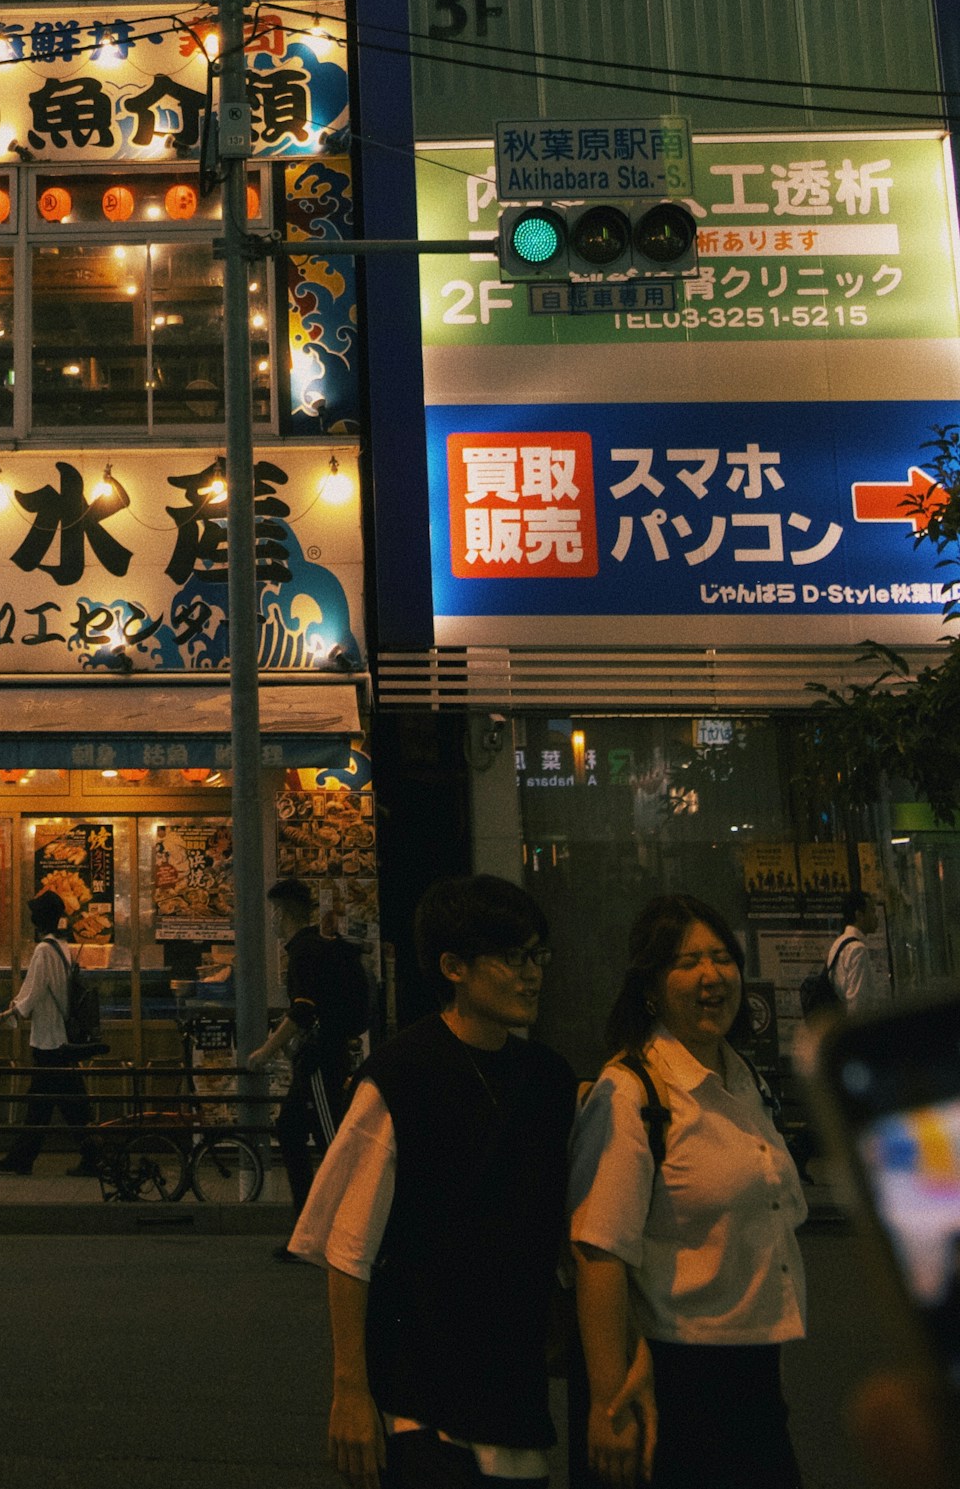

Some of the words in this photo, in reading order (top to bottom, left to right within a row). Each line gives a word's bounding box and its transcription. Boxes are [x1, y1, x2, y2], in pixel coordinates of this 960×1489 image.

[503, 128, 683, 163] 秋葉原駅南
[508, 167, 609, 191] Akihabara
[441, 279, 515, 325] 2F
[462, 447, 579, 503] 買取
[610, 443, 785, 500] スマホ
[464, 507, 583, 564] 販売
[611, 508, 843, 566] パソコン
